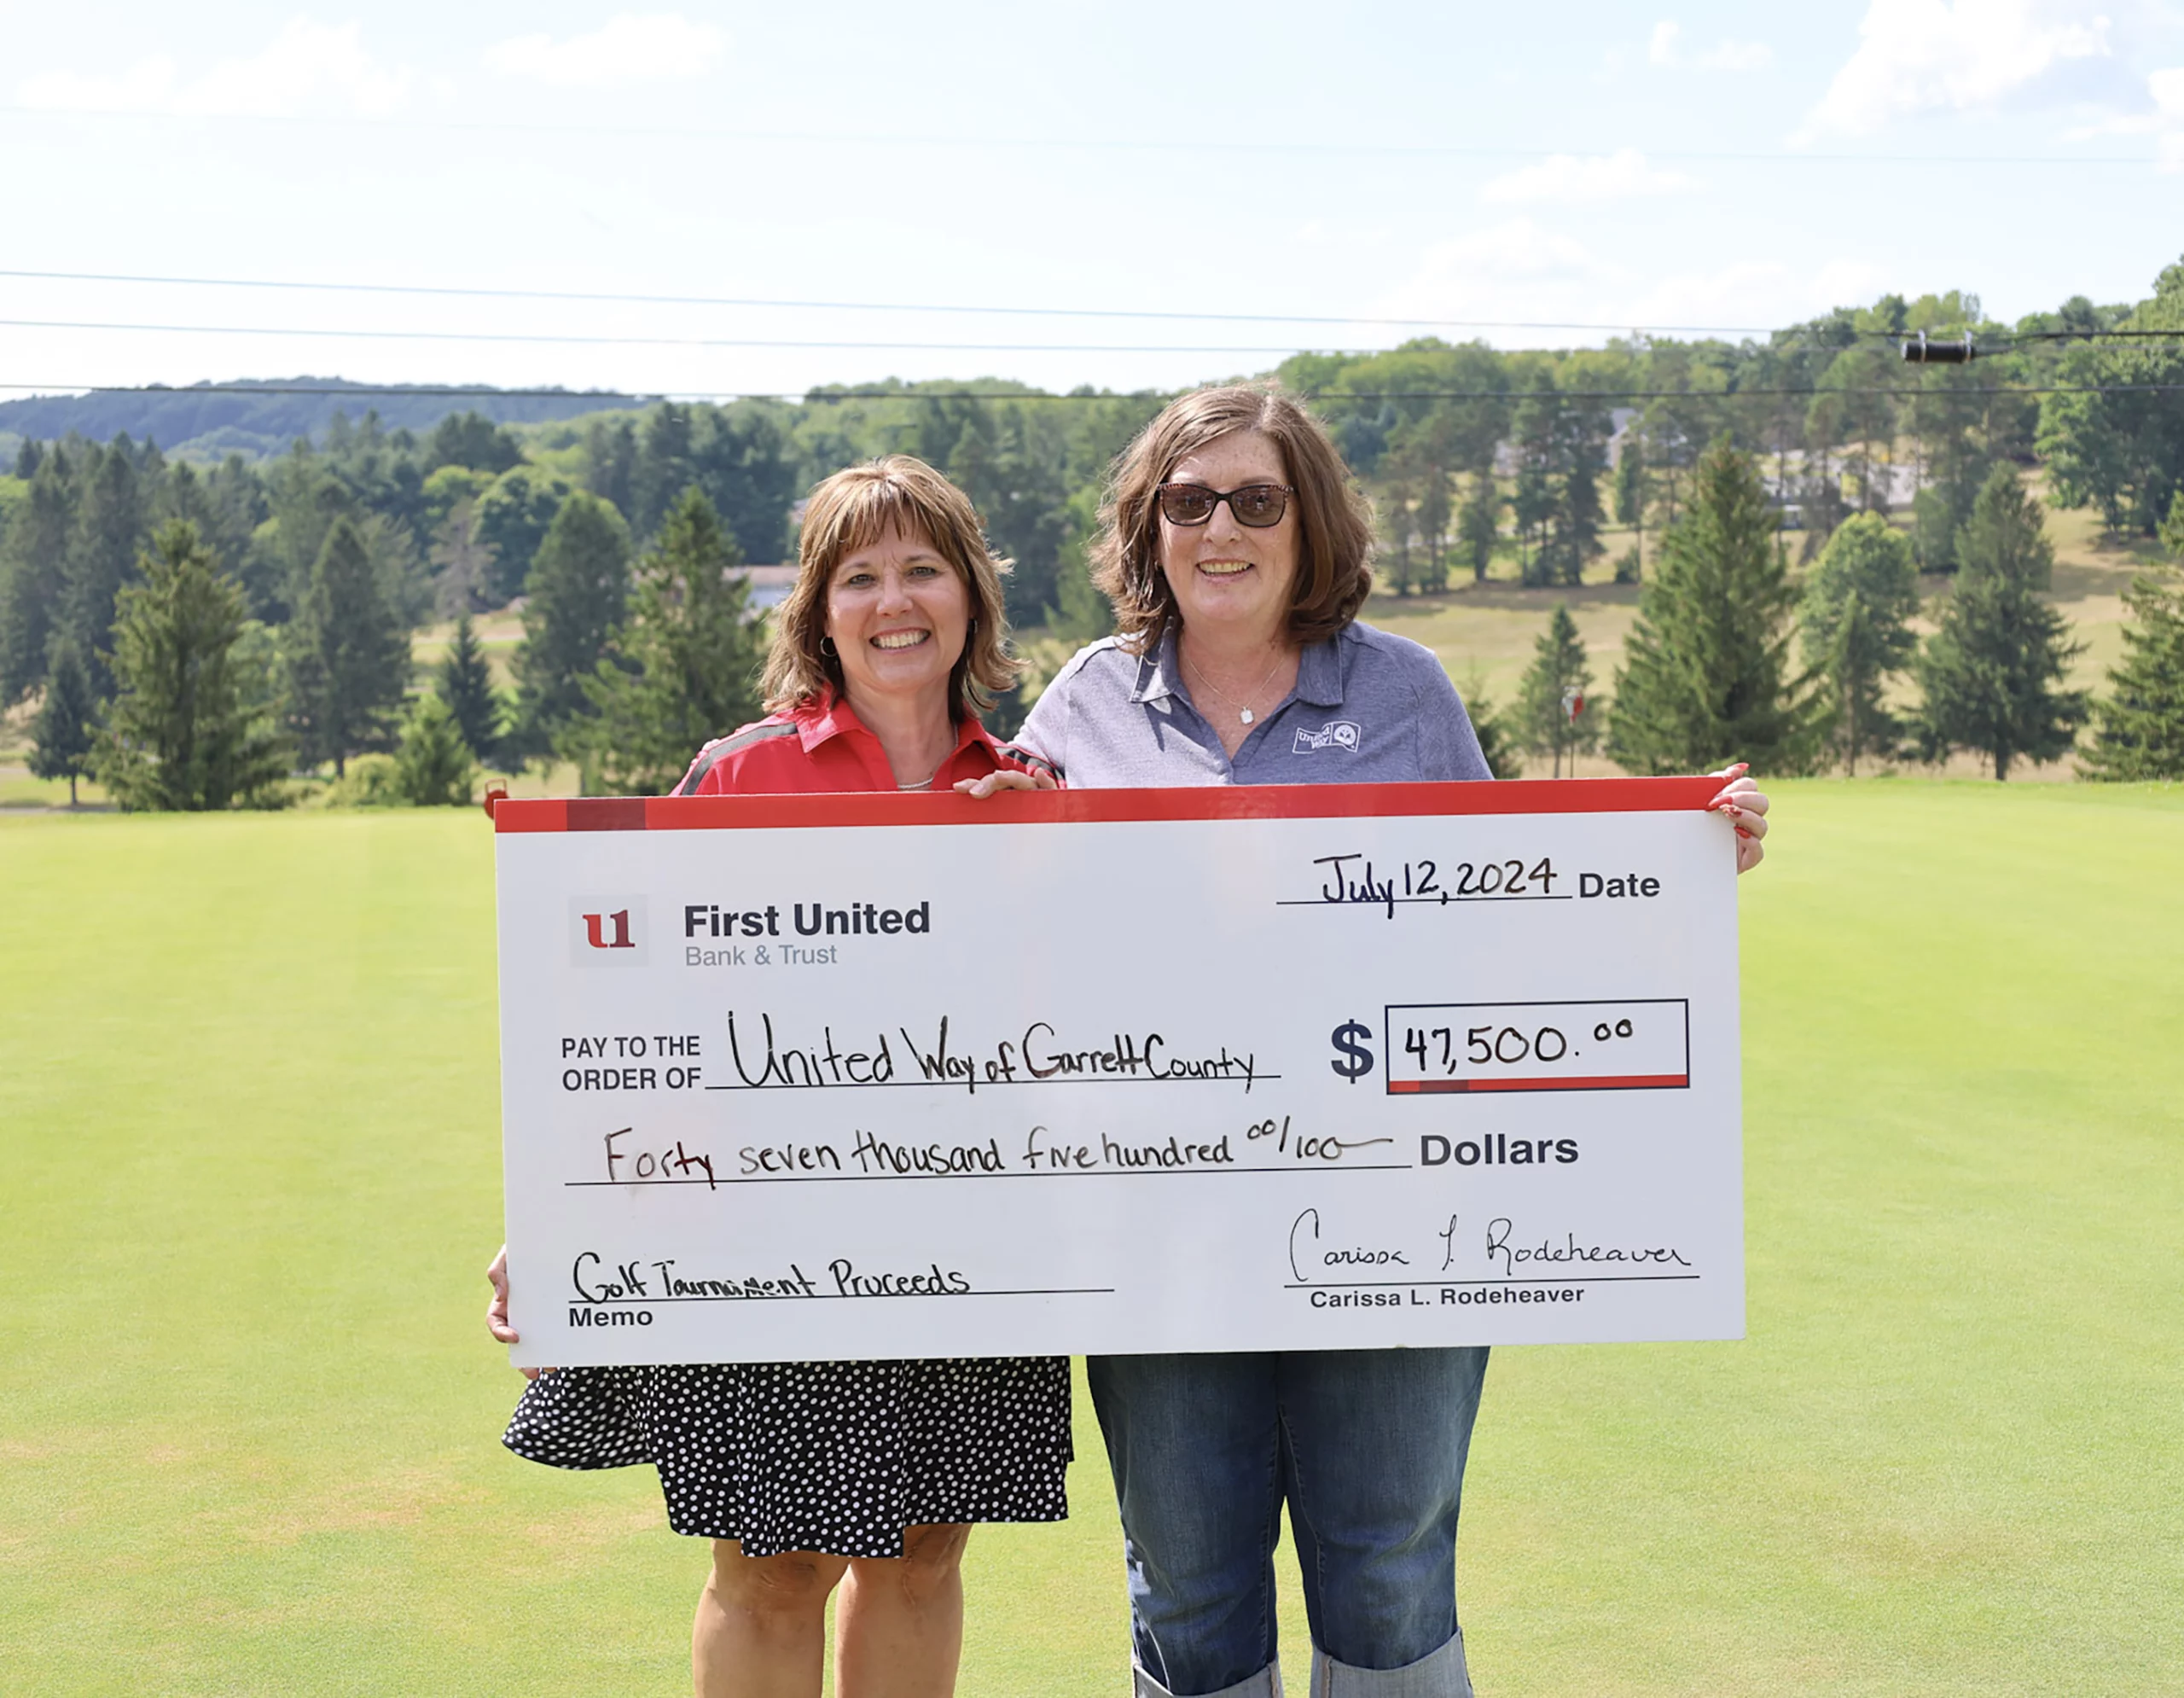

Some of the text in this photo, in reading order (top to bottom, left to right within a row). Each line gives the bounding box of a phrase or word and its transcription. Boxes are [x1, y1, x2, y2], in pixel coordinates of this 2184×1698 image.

[1312, 853, 1393, 919] July
[1456, 857, 1558, 896] 2024
[1579, 872, 1661, 898] Date
[684, 901, 930, 938] First United
[685, 944, 838, 966] Bank & Trust
[561, 1035, 701, 1058] PAY TO THE
[728, 1010, 1254, 1095] United Way of Garrett County
[562, 1067, 701, 1091] ORDER OF
[604, 1126, 717, 1190] Forty
[739, 1142, 841, 1175] seven
[851, 1129, 1006, 1175] thousand
[1023, 1126, 1097, 1170] five
[1101, 1132, 1234, 1168] hundred
[1420, 1133, 1579, 1166] Dollars
[572, 1251, 647, 1304] Golf
[1310, 1287, 1585, 1309] Carissa L. Rodeheaver
[568, 1308, 654, 1328] Memo
